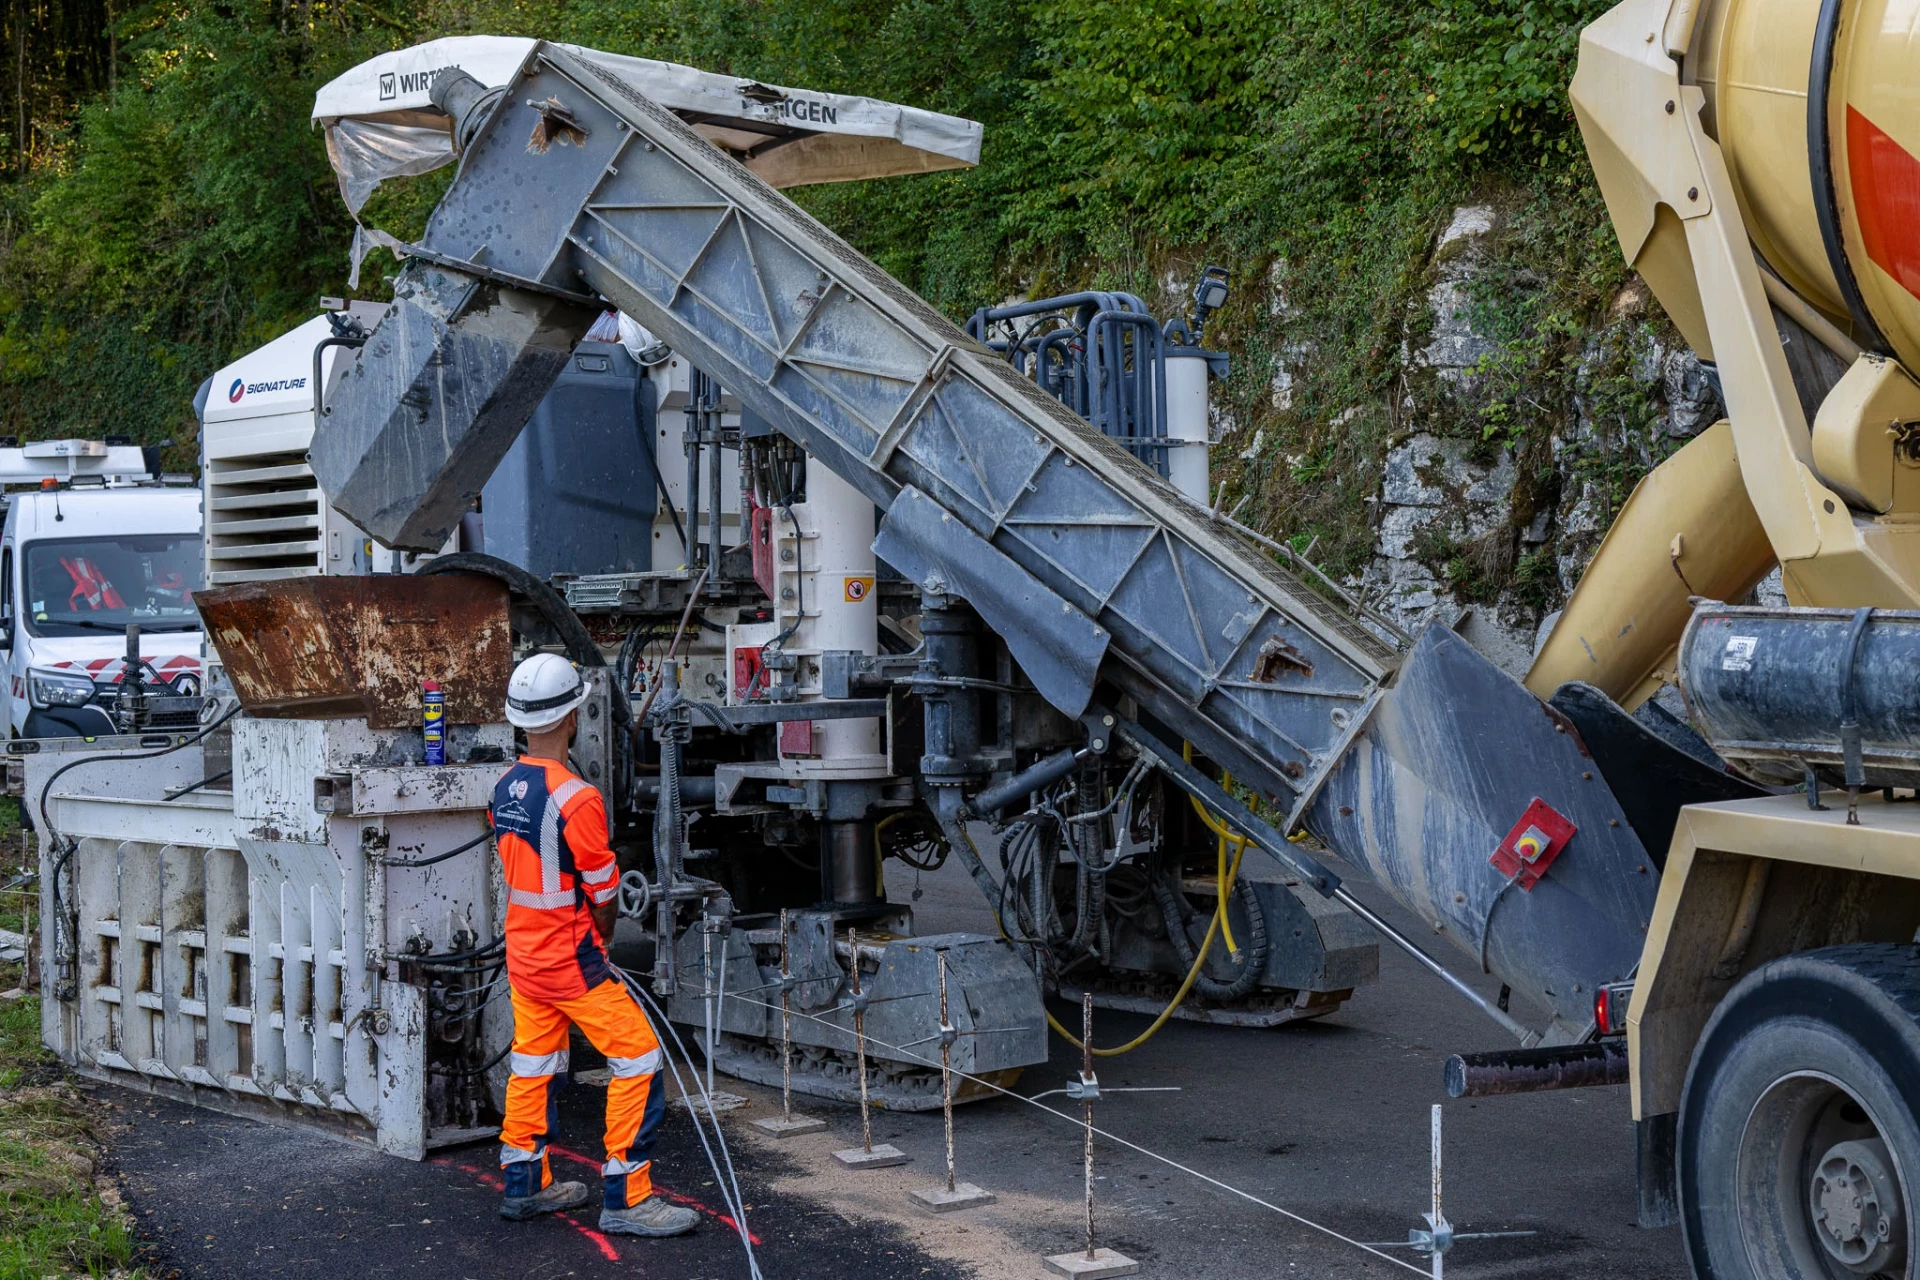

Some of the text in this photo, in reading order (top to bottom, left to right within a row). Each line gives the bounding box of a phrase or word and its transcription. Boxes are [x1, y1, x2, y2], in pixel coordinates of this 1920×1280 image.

[400, 64, 460, 93] WIRT
[742, 98, 837, 124] TGEN
[247, 378, 306, 394] SIGNATURE
